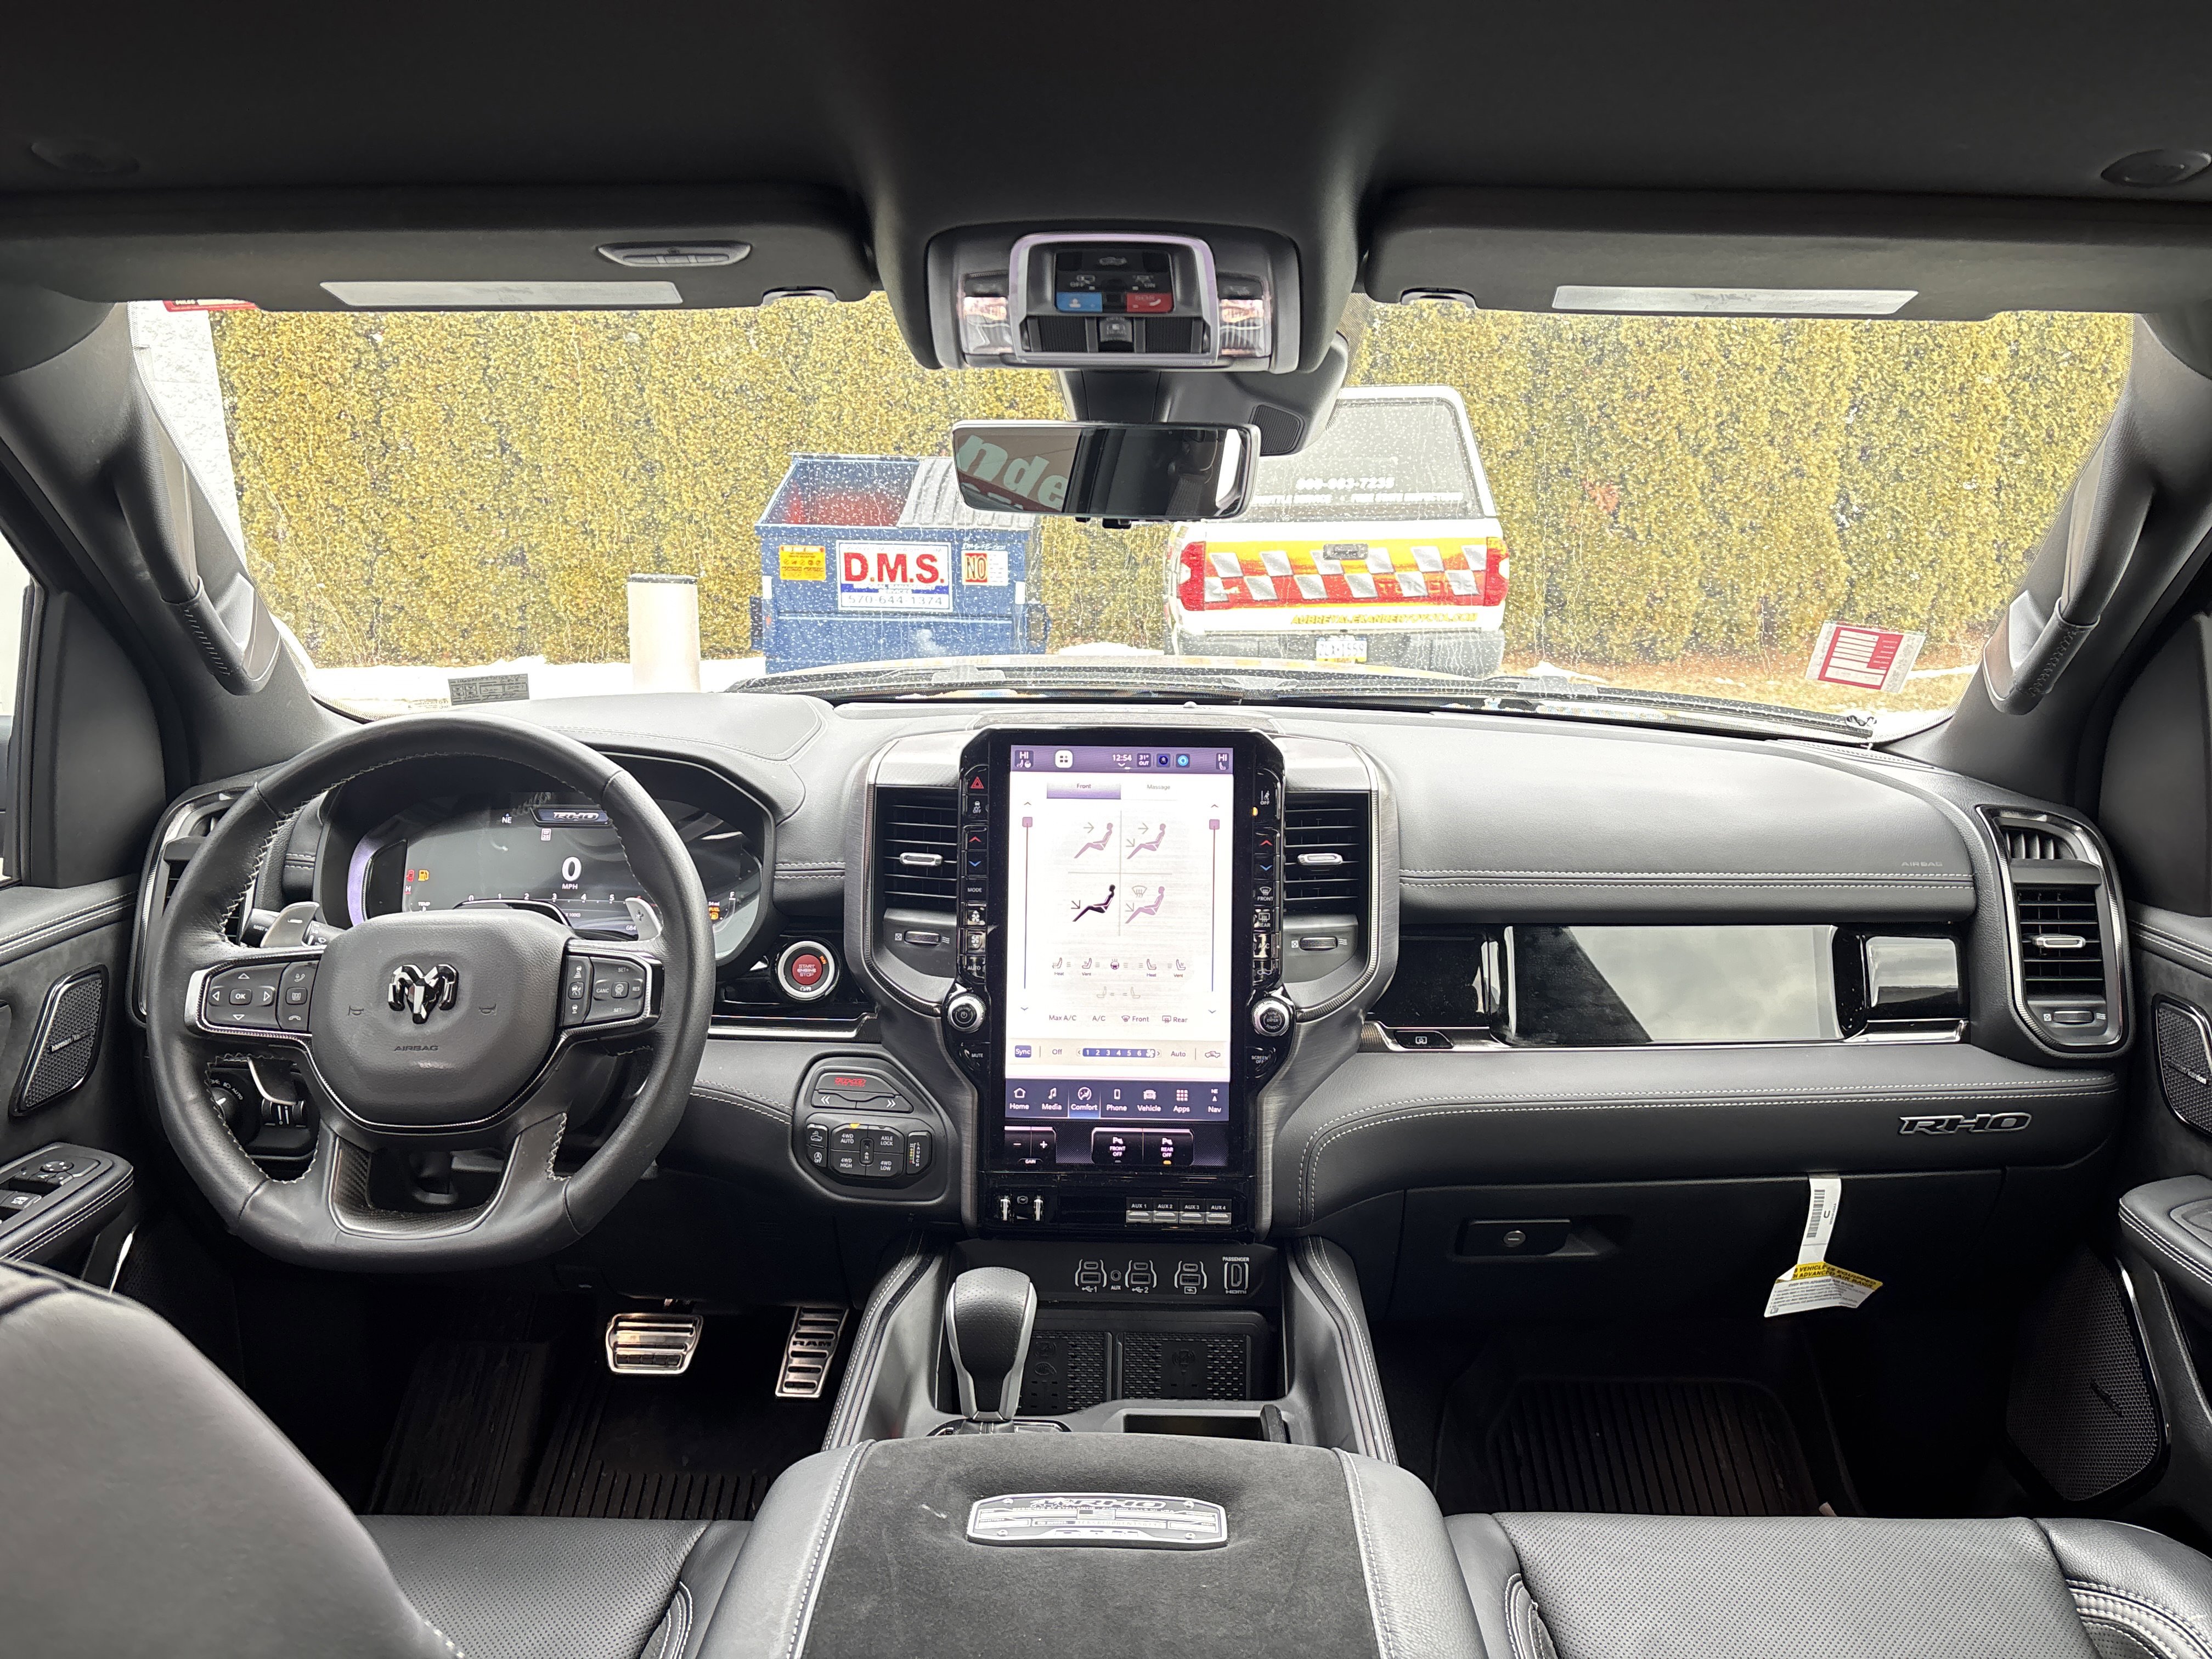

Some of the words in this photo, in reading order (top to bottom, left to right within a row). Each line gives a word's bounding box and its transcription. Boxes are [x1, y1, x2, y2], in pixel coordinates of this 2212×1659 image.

[844, 552, 944, 583] D.M.S.
[967, 557, 986, 579] NO
[849, 595, 942, 605] 570-644-1374
[562, 856, 582, 882] 0
[232, 1088, 242, 1100] AUTO
[1899, 1112, 2032, 1135] RHO
[1073, 1499, 1166, 1508] RHO
